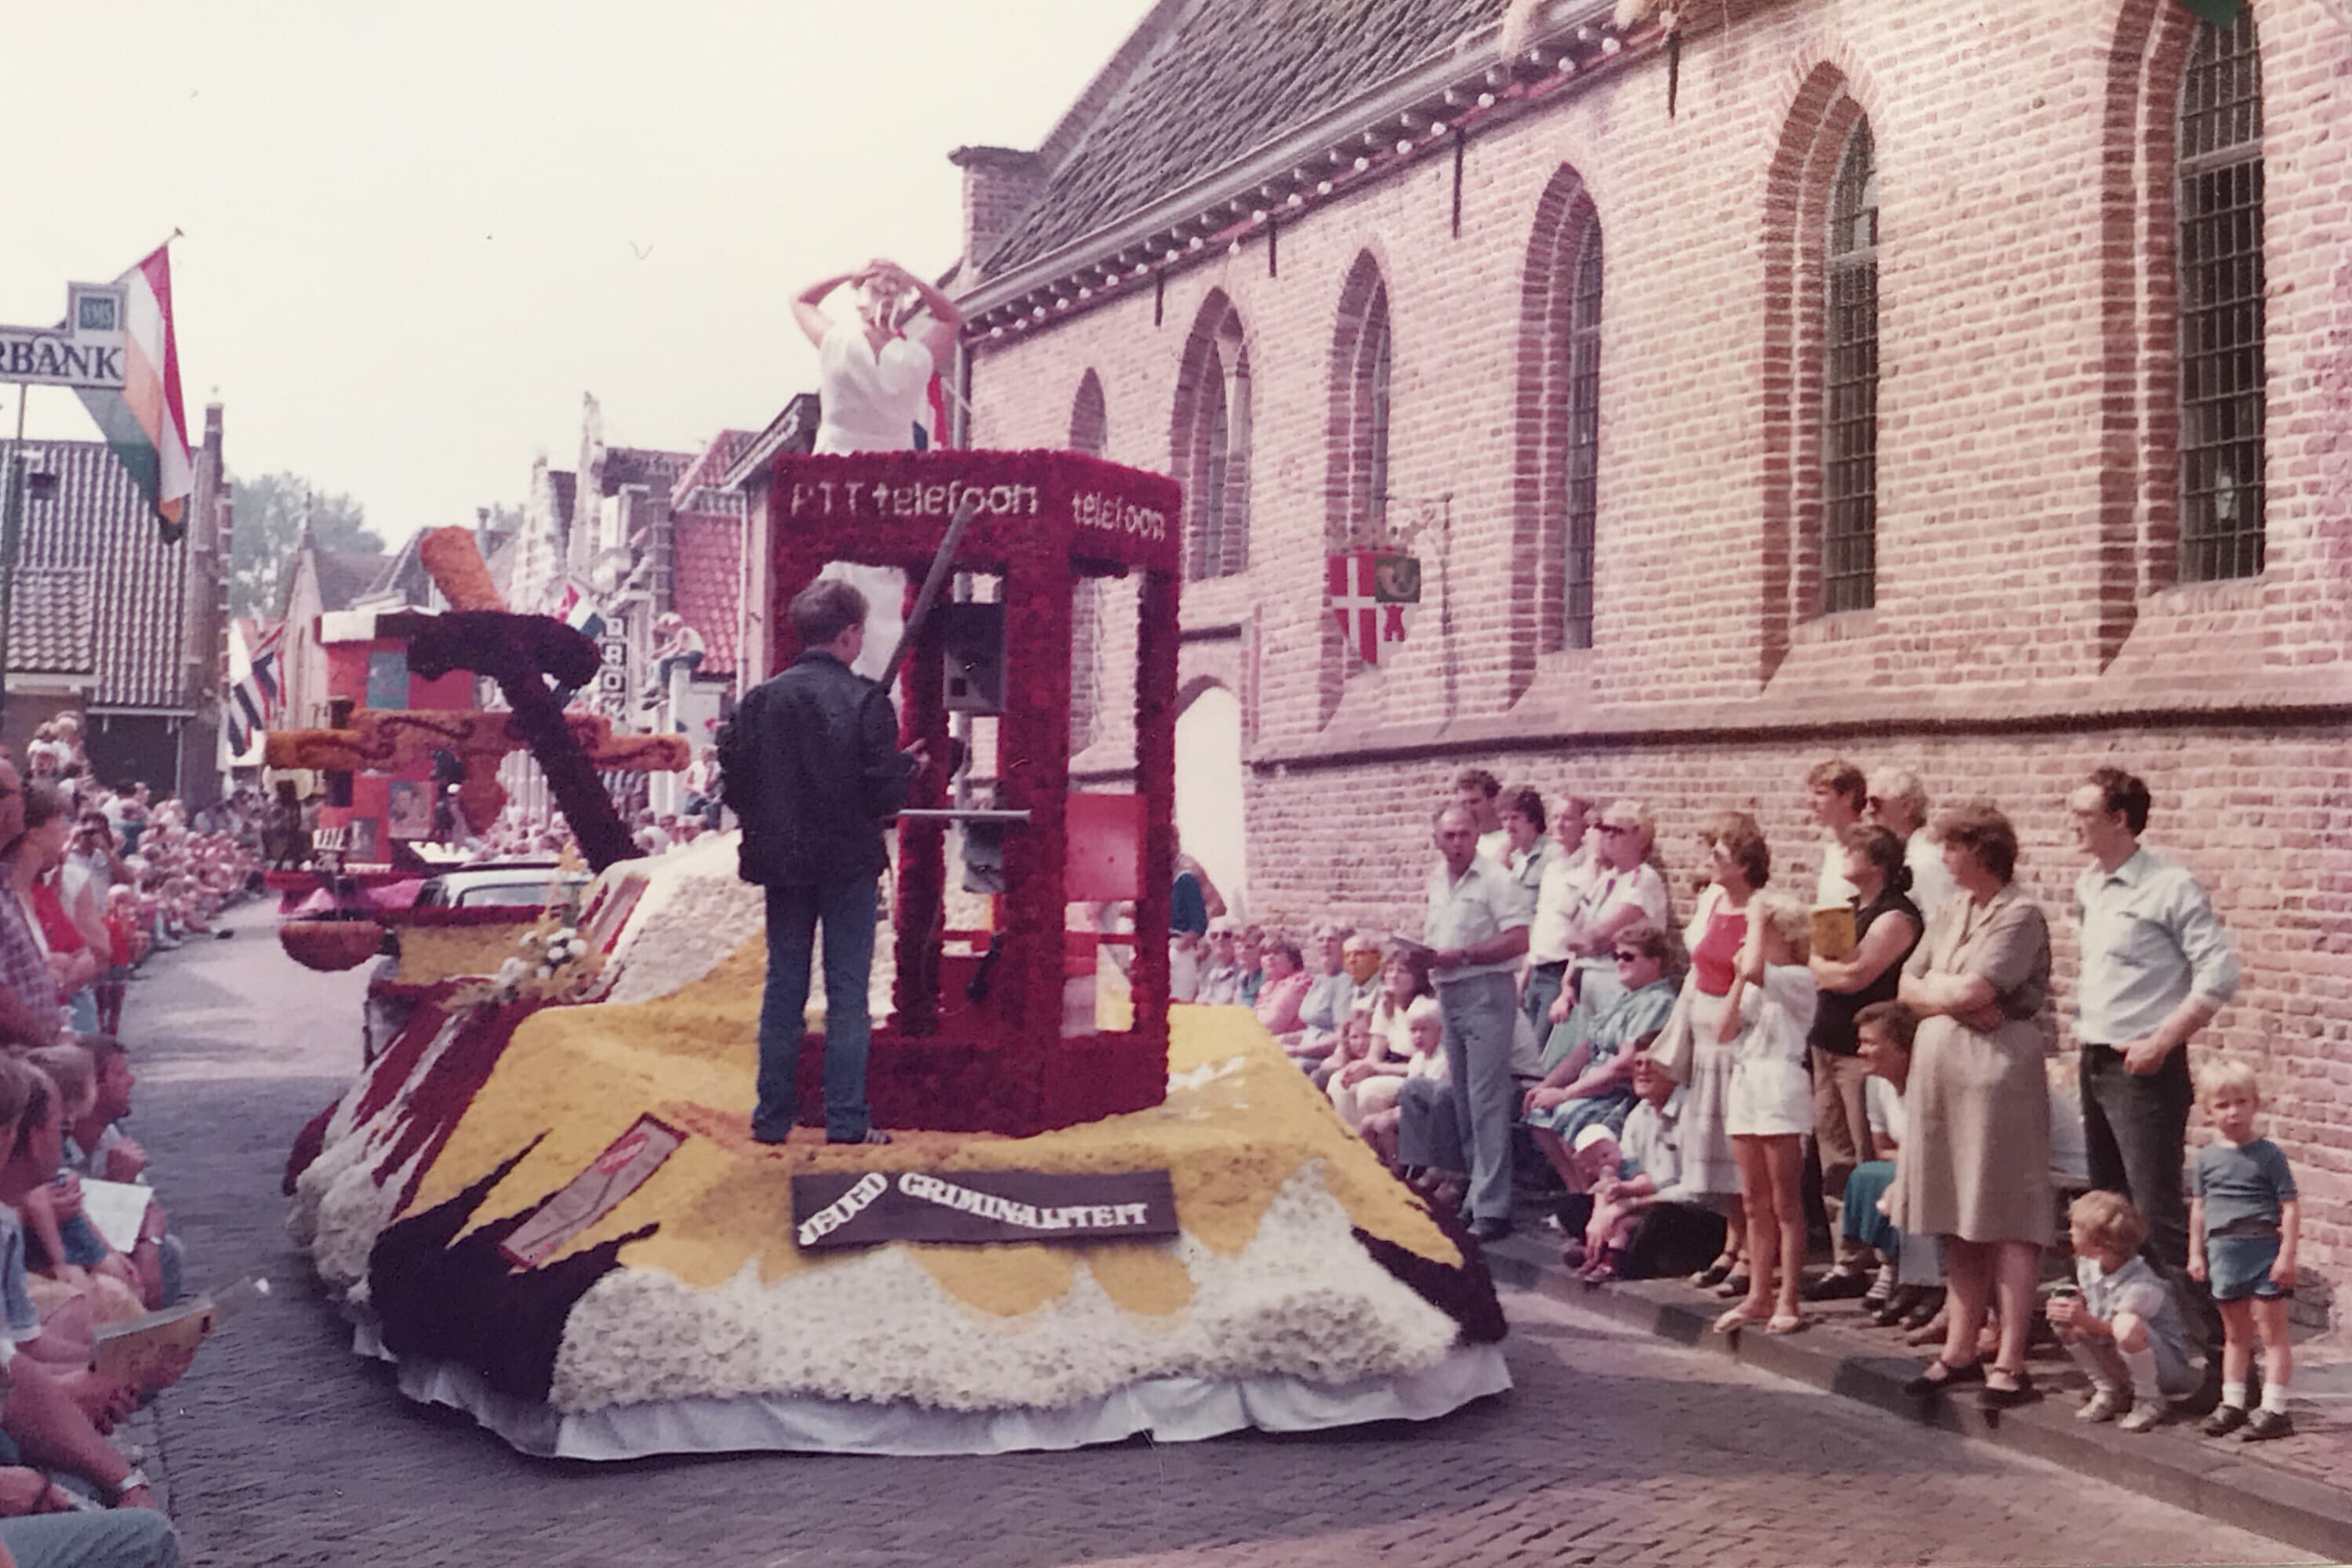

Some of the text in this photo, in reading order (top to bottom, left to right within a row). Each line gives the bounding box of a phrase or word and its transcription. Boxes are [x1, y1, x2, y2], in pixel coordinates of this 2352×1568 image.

[791, 479, 1038, 517] PTT telefoon
[1072, 491, 1166, 542] telefoon
[797, 1172, 1149, 1245] JEUGD CRIMINALITEIT
